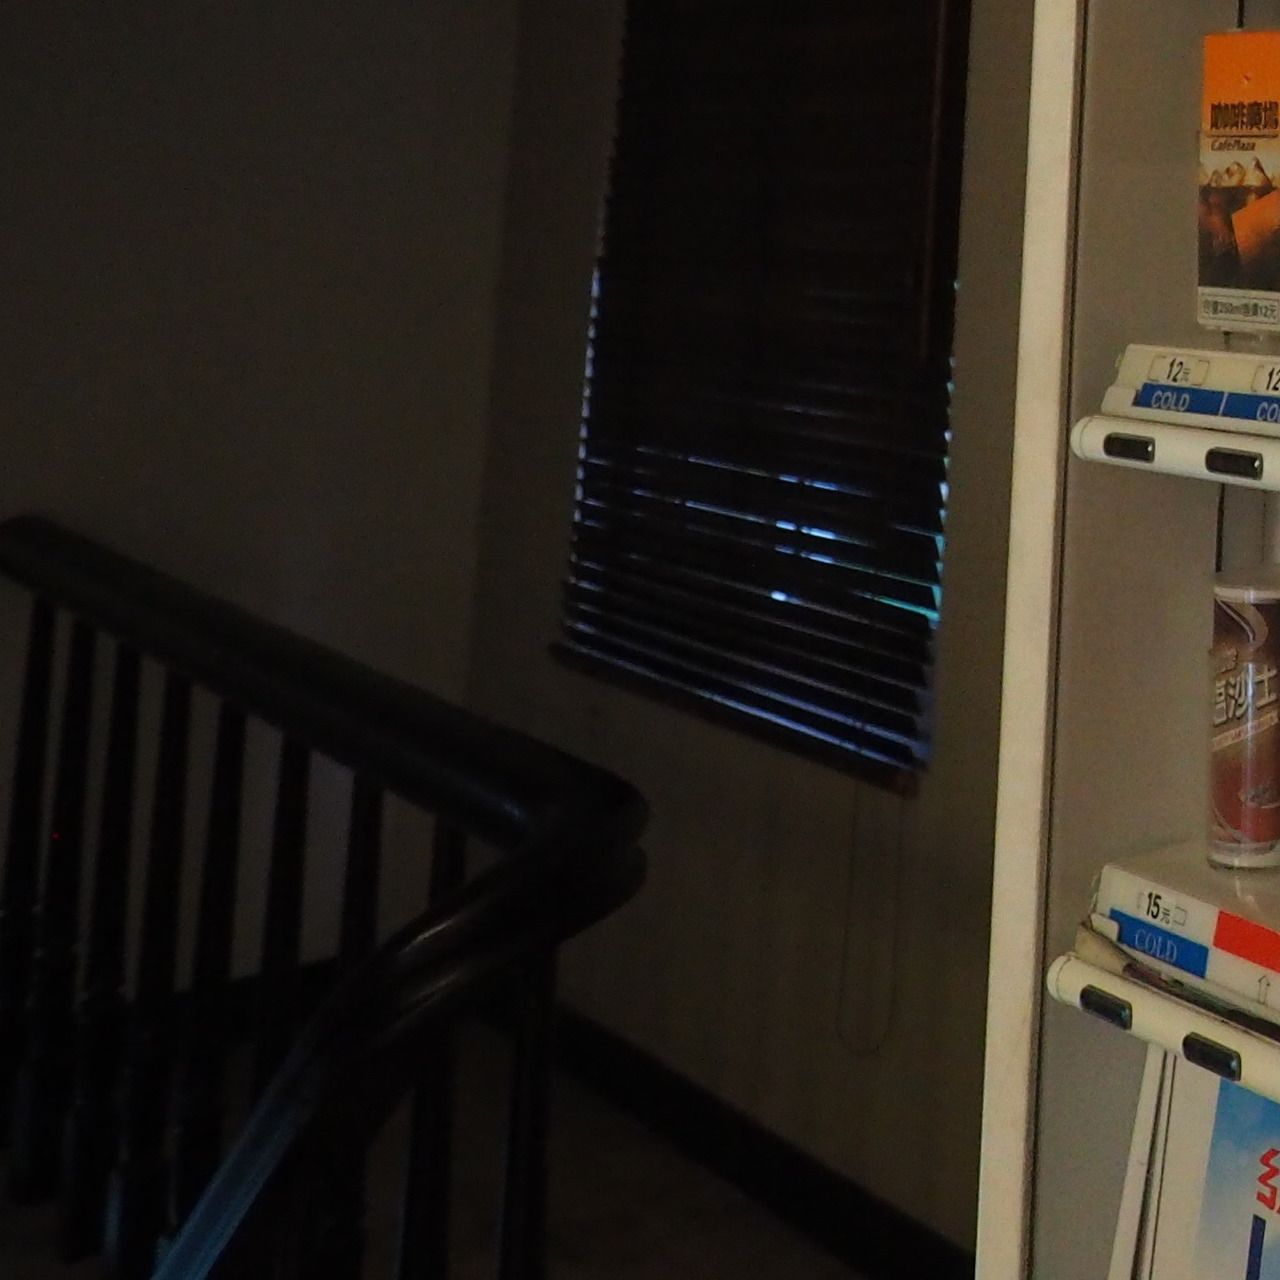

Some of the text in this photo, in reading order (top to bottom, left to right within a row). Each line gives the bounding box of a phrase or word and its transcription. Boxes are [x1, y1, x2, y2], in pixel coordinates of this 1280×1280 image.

[1167, 359, 1190, 383] 12元
[1152, 390, 1189, 412] COLD
[1134, 929, 1178, 962] COLD
